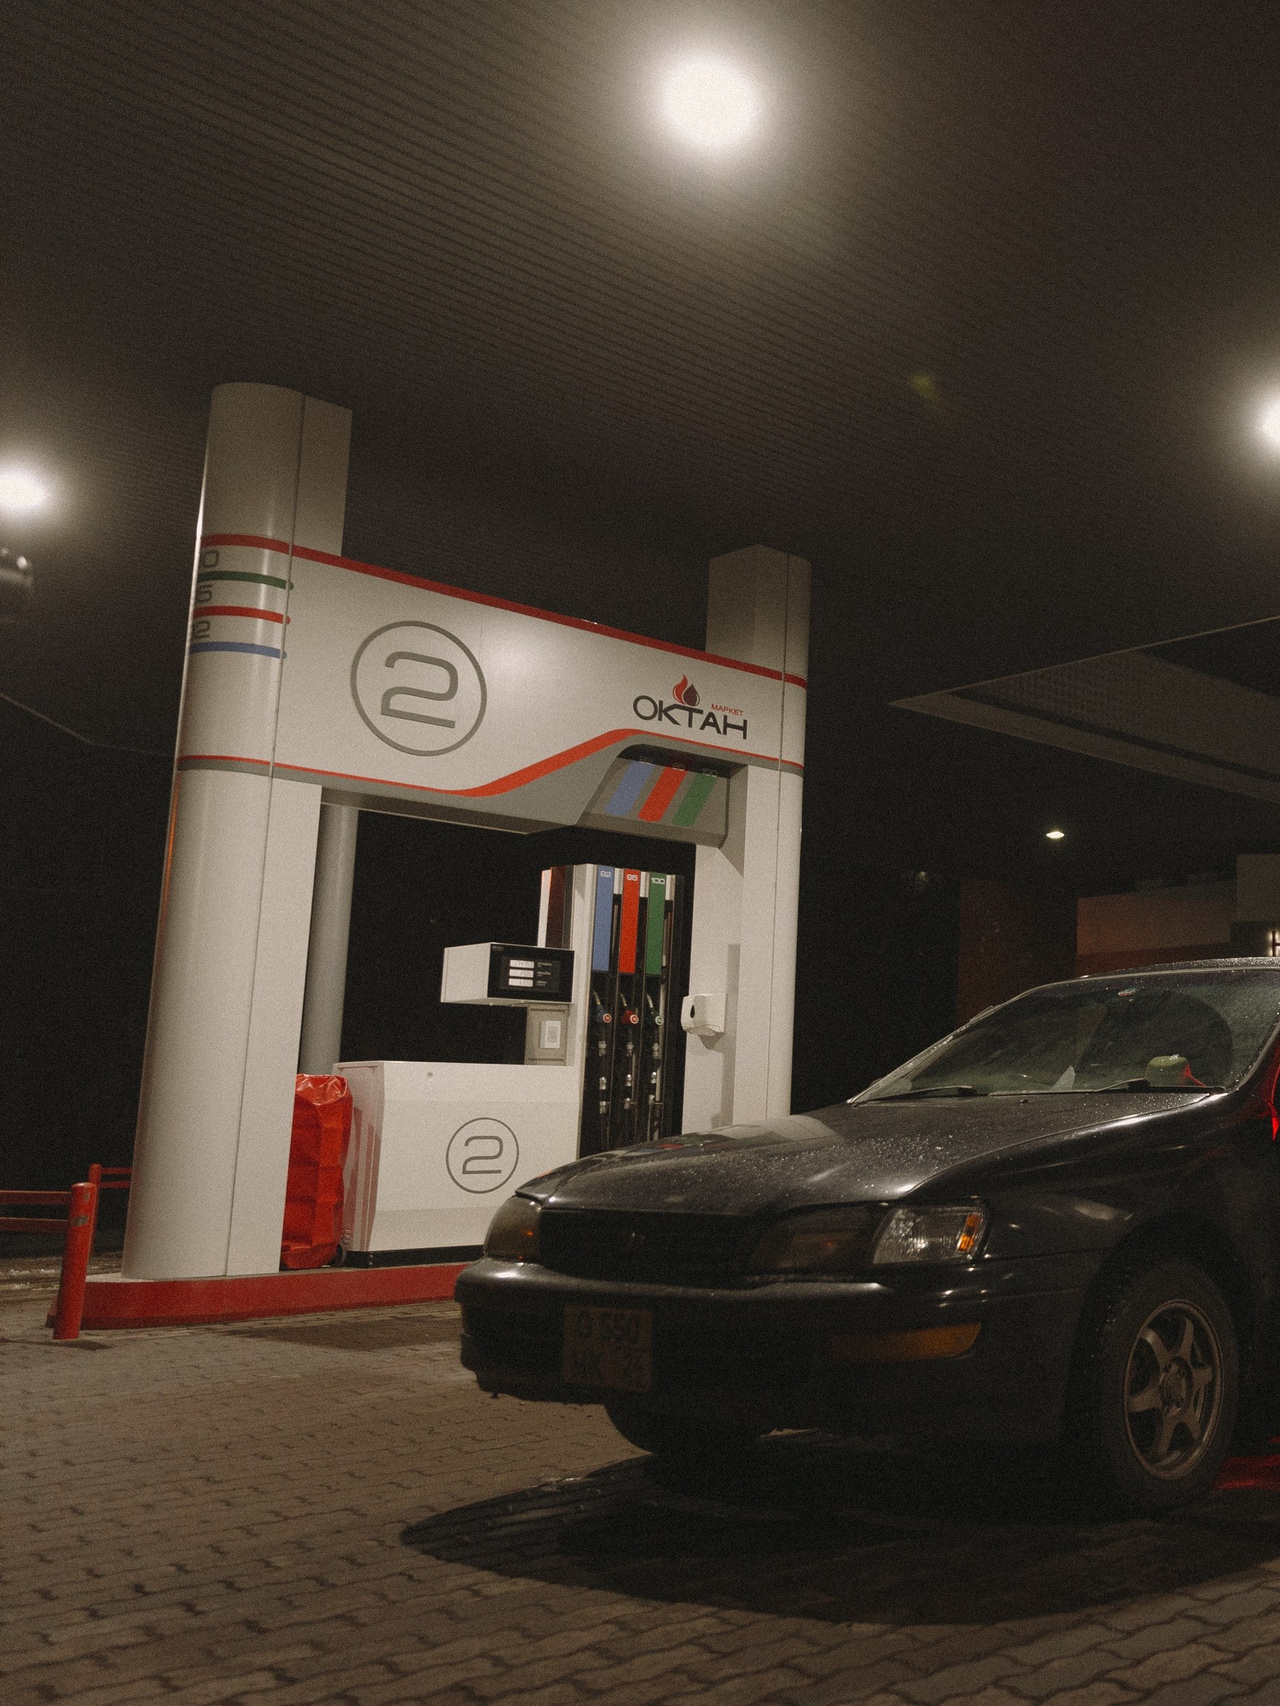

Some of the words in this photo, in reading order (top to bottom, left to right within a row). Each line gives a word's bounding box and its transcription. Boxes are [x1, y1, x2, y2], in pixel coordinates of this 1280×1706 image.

[380, 650, 459, 729] 2
[710, 703, 745, 717] МАРКЕТ
[632, 695, 748, 740] ОКТАН
[651, 877, 666, 885] 100
[462, 1134, 504, 1175] 2
